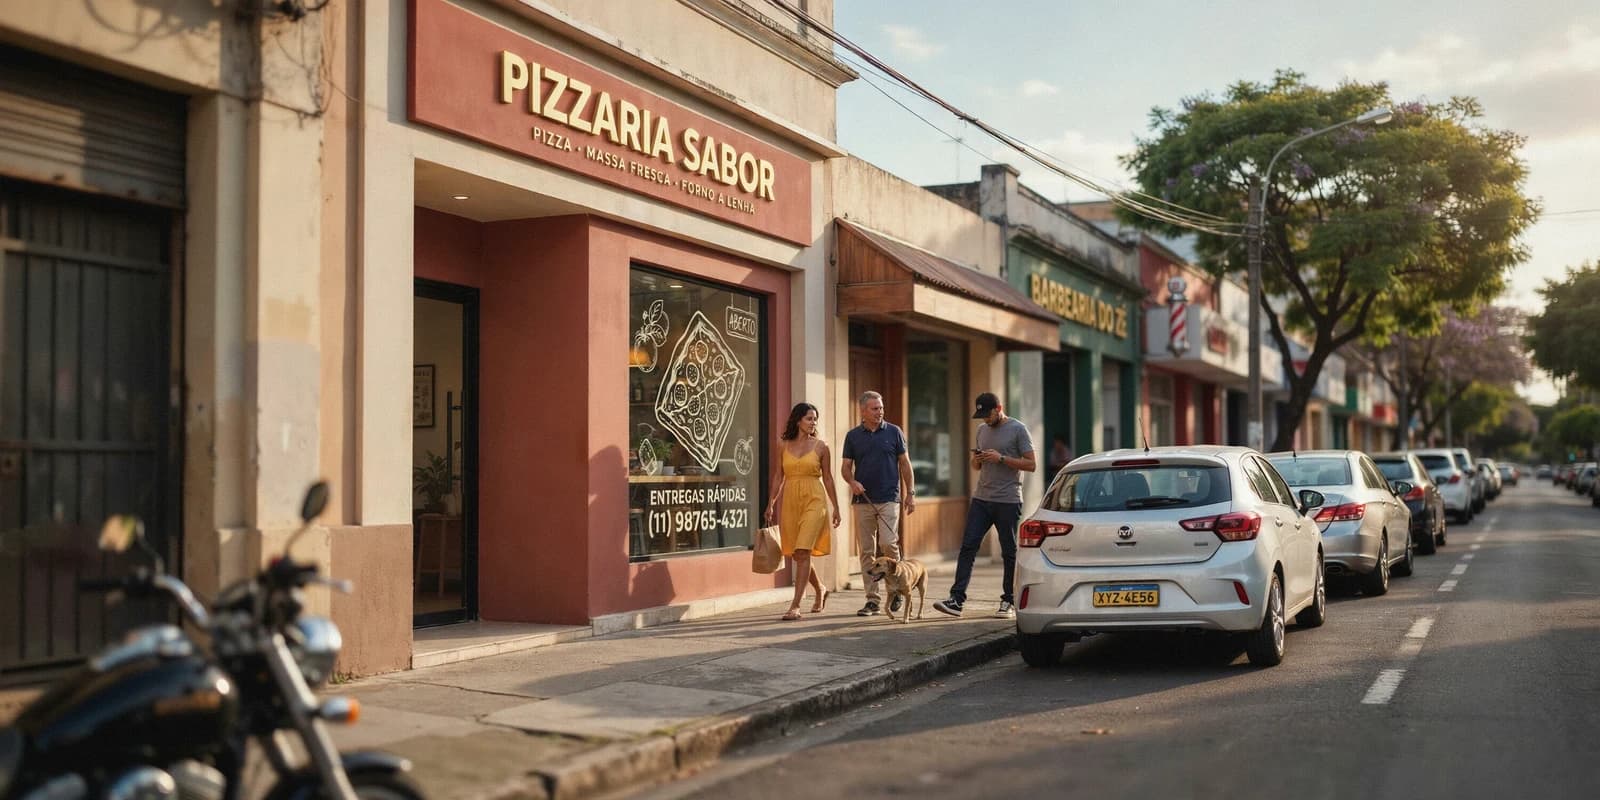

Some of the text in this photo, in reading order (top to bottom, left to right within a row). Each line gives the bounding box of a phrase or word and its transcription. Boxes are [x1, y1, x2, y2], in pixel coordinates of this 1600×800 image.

[501, 50, 775, 201] PIZZARIA SABOR
[533, 126, 756, 215] PIZZA MASSA FRESCA FORNO A LENHA
[729, 312, 756, 336] ABERTO
[1031, 272, 1128, 338] BARBEARIA DO ZÉ
[650, 484, 746, 506] ENTREGAS RÁPIDAS
[648, 508, 748, 538] (11) 98765-4321
